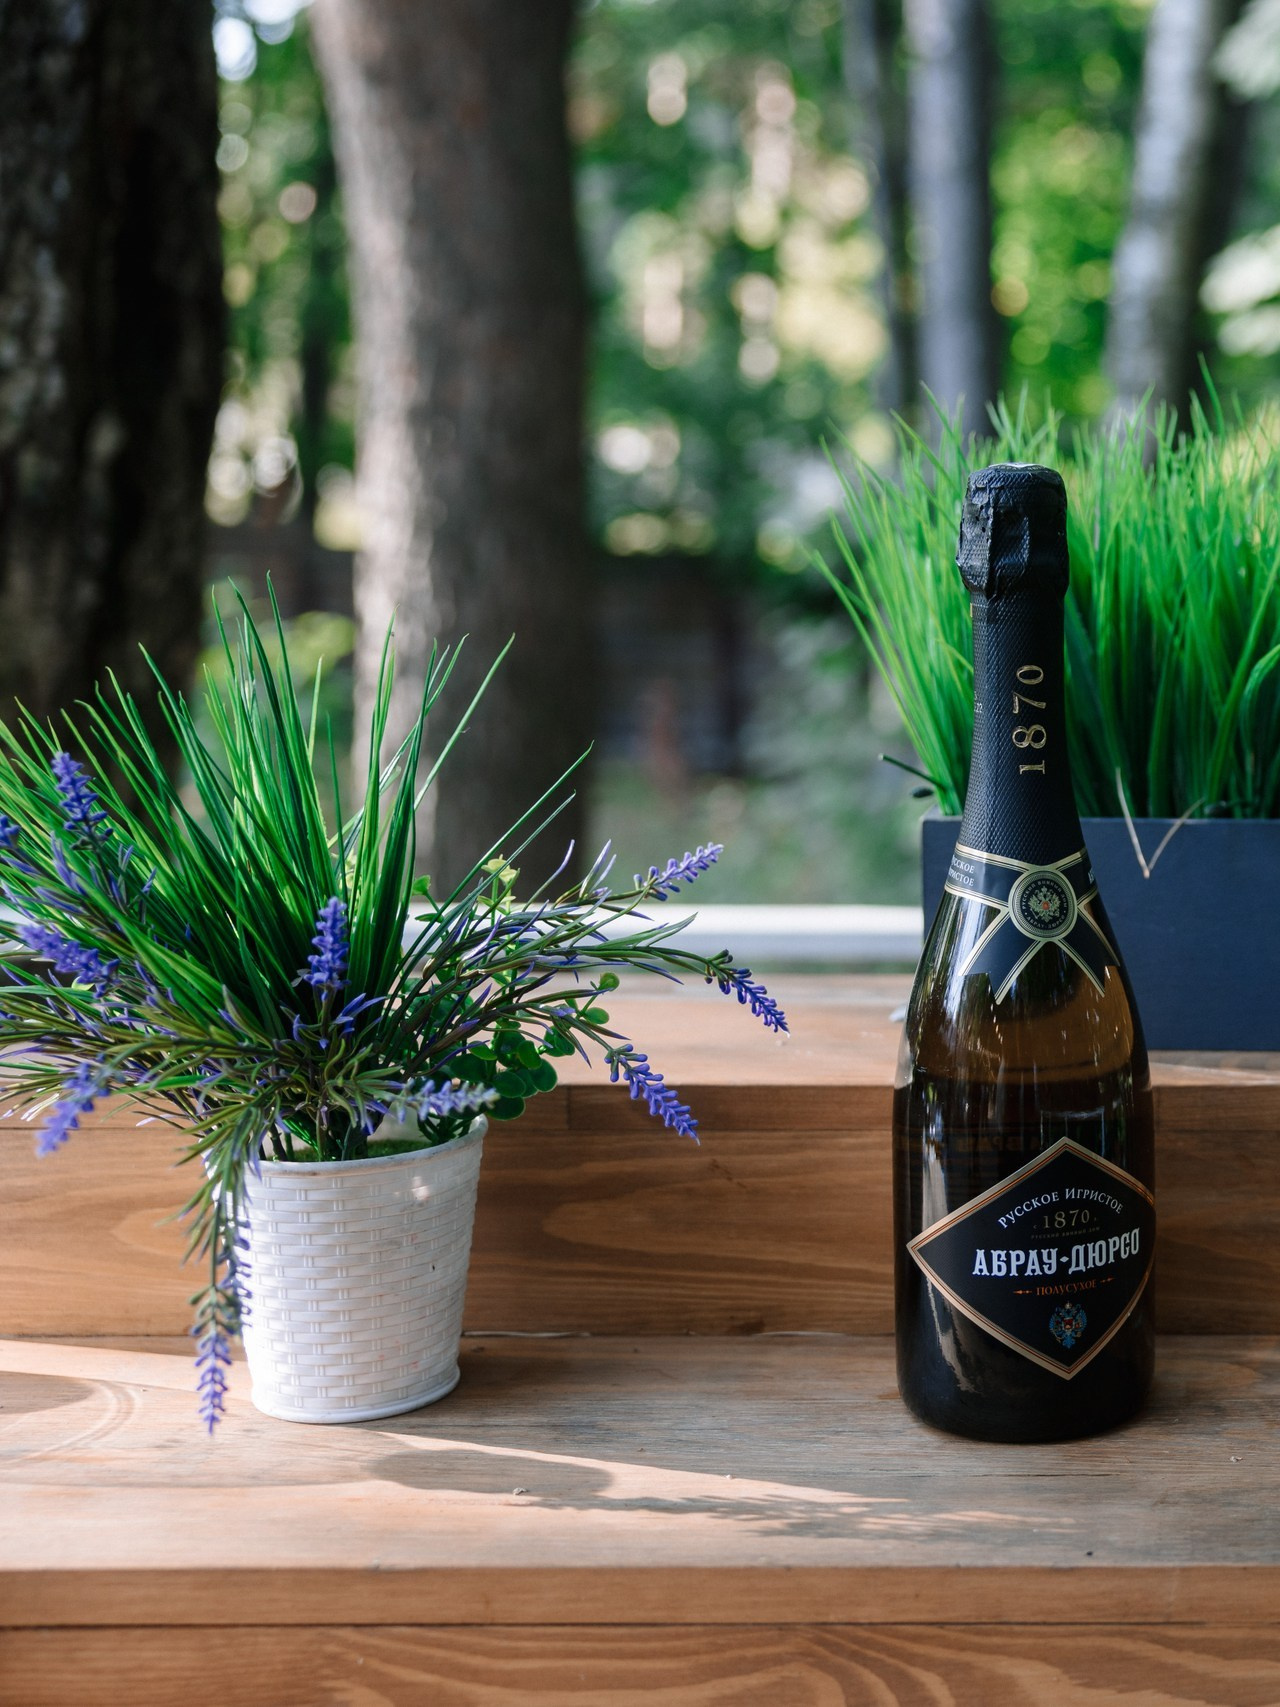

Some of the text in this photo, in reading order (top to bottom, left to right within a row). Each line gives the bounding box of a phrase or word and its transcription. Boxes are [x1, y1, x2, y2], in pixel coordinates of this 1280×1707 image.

[1012, 665, 1047, 775] 1870
[998, 1187, 1124, 1229] РУССКОЕ ИГРИСТОЕ
[1043, 1208, 1090, 1229] 1870
[972, 1227, 1141, 1277] АБРАУ-ДЮРСО
[1036, 1279, 1097, 1297] ПОЛУСУХОЕ
